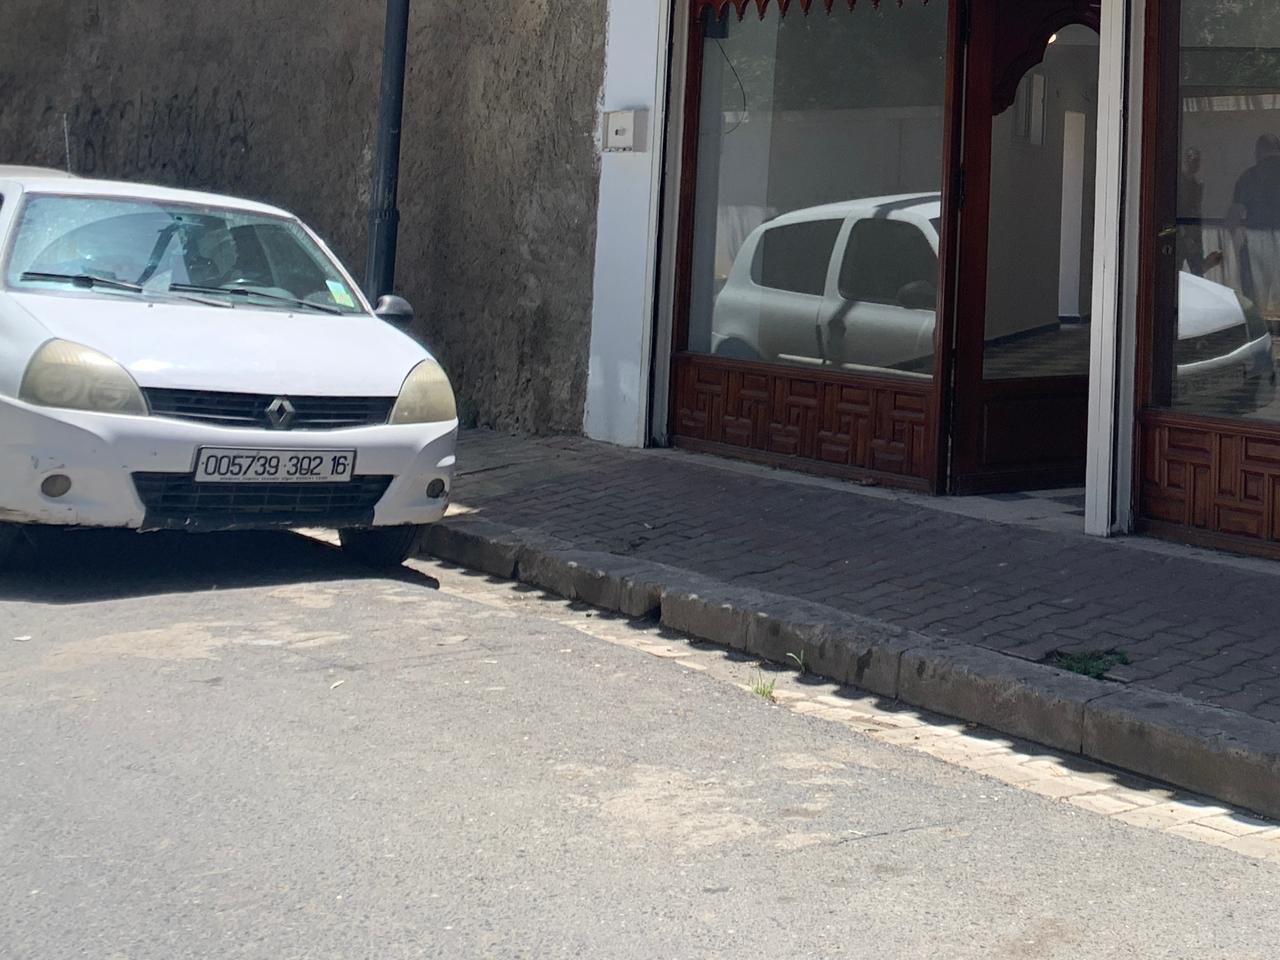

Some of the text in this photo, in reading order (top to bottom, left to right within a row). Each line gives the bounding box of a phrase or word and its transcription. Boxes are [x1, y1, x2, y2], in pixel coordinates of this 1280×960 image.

[204, 455, 347, 476] 005739 302 16
